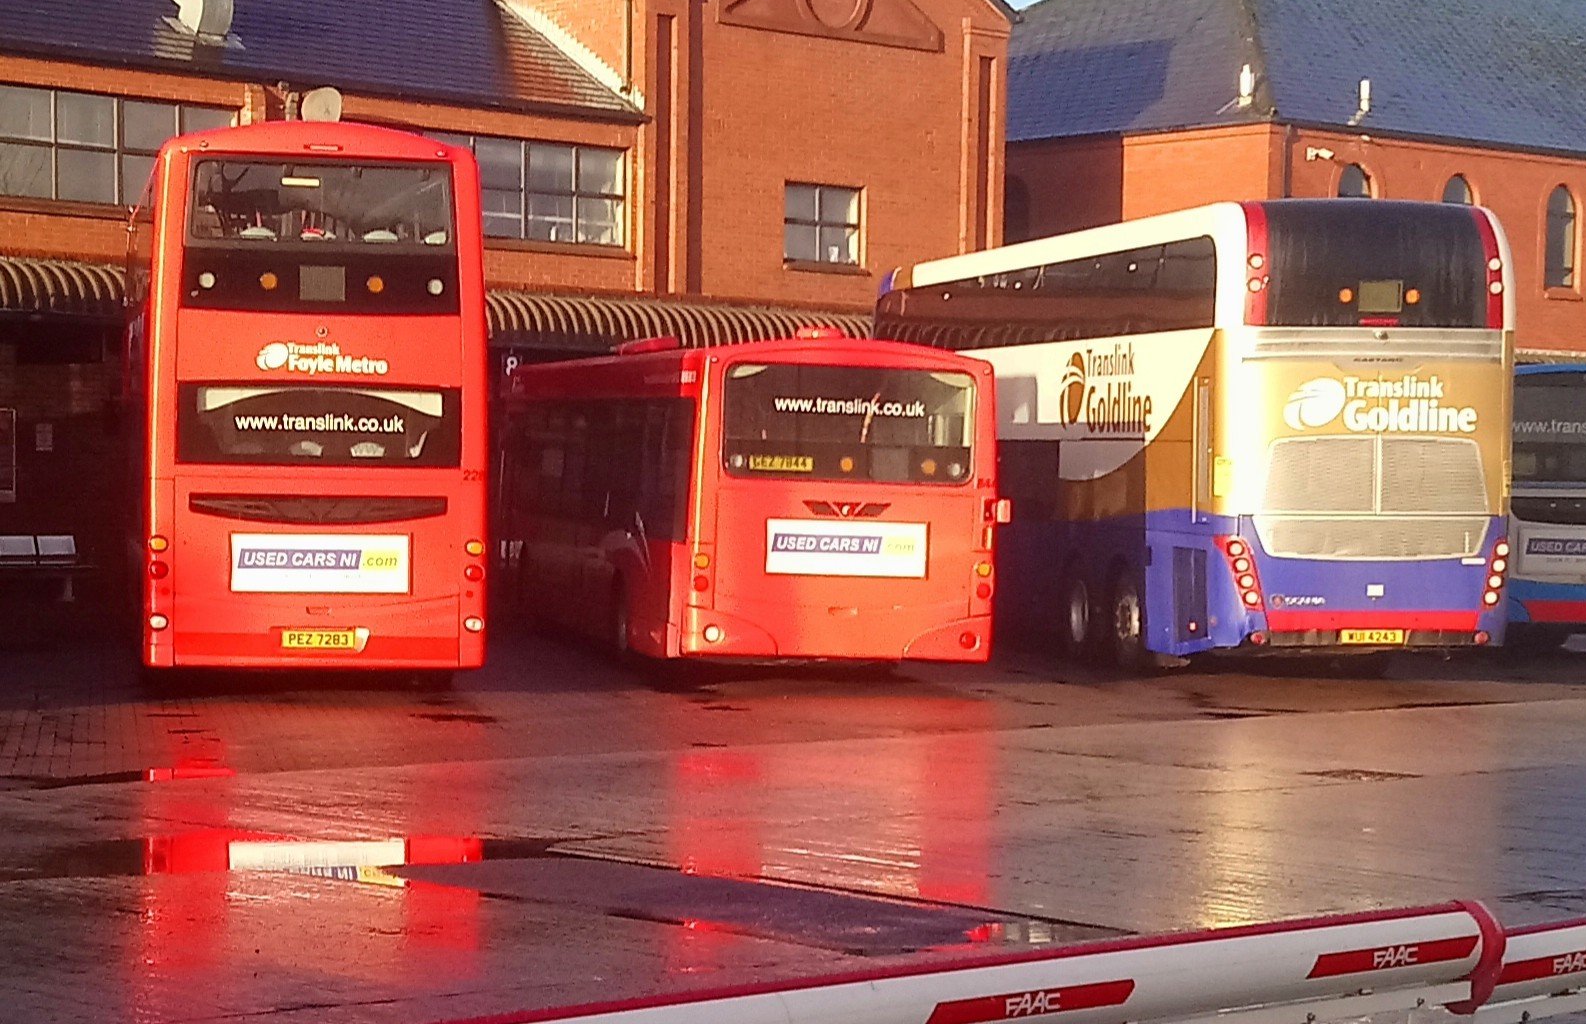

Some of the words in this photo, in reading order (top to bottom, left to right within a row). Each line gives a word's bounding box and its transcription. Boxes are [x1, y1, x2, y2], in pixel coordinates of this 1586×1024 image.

[289, 342, 340, 355] Translink
[289, 356, 333, 374] Foyle
[336, 357, 388, 374] Metro
[1087, 342, 1134, 377] Translink
[1344, 376, 1443, 397] Translink
[773, 396, 925, 418] www.translink.co.uk
[1087, 381, 1152, 433] Goldline
[1343, 399, 1478, 433] Goldline
[235, 413, 404, 432] www.translink.co.uk
[776, 536, 817, 550] USED
[819, 537, 860, 552] CARS
[863, 538, 879, 552] NI
[1530, 540, 1563, 552] USED
[243, 551, 288, 566] USED
[291, 552, 336, 567] CARS
[339, 552, 357, 567] NI
[362, 556, 398, 567] .com
[288, 633, 314, 645] PEZ
[317, 634, 349, 646] 7283
[1368, 631, 1396, 642] 4243
[1373, 945, 1419, 967] FAAC
[1005, 991, 1061, 1017] FAAC
